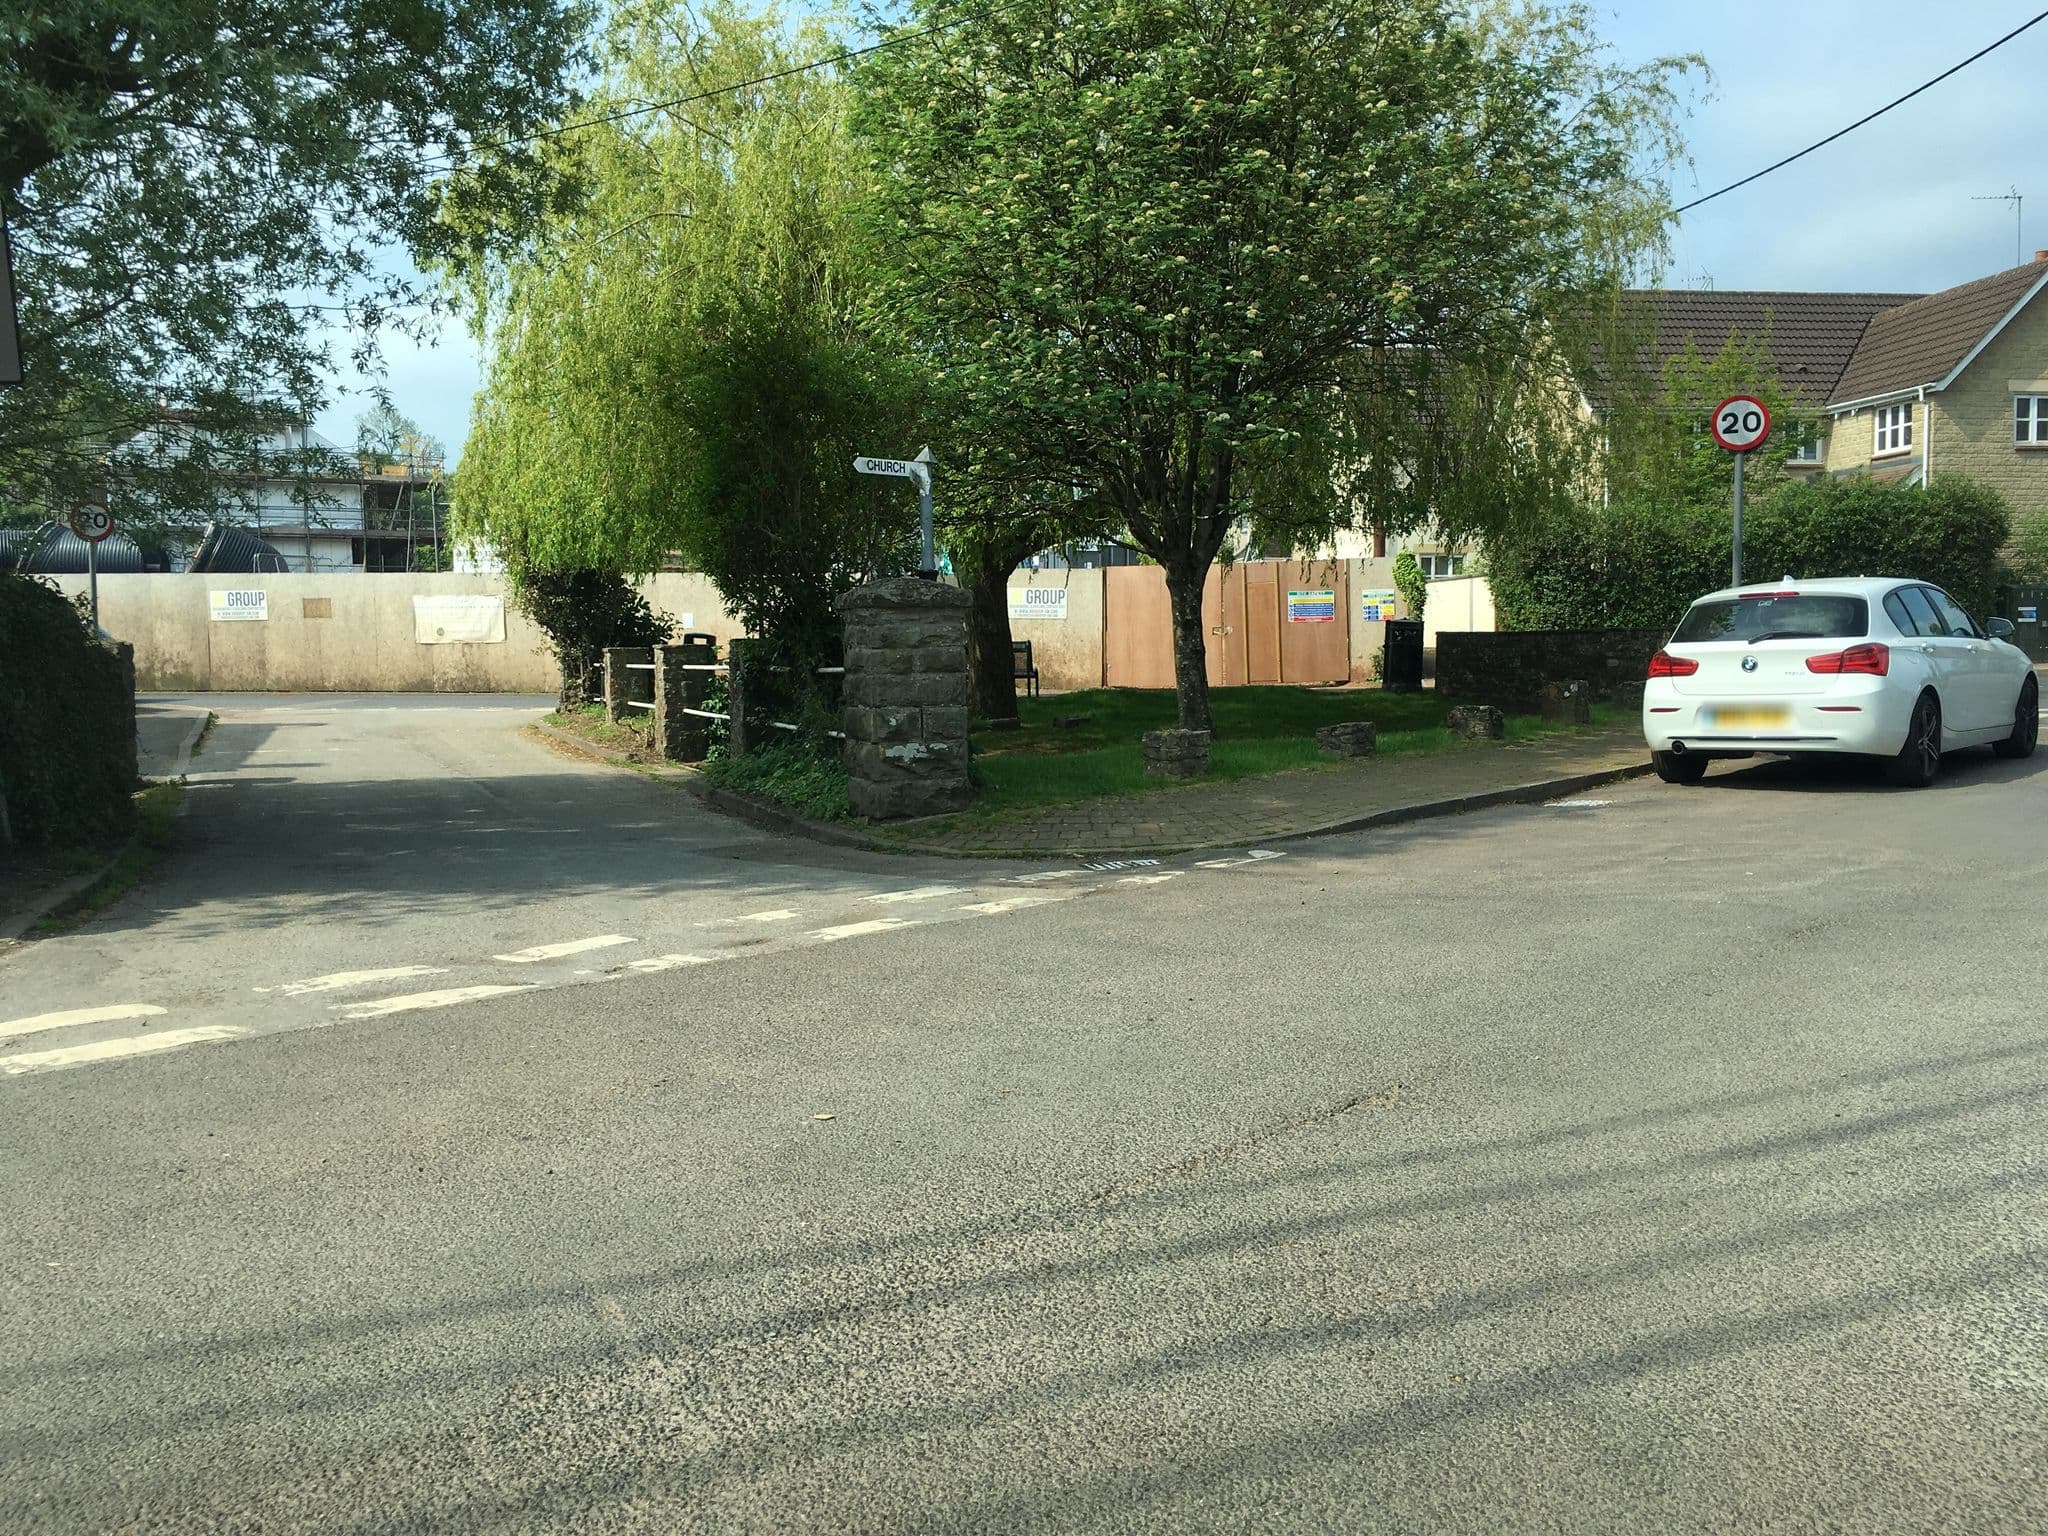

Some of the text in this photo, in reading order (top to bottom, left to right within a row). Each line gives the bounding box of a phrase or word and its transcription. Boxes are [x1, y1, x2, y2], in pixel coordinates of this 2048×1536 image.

[1722, 411, 1761, 434] 20
[866, 459, 906, 473] CHURCH
[227, 591, 265, 606] GROUP
[1026, 589, 1065, 604] GROUP
